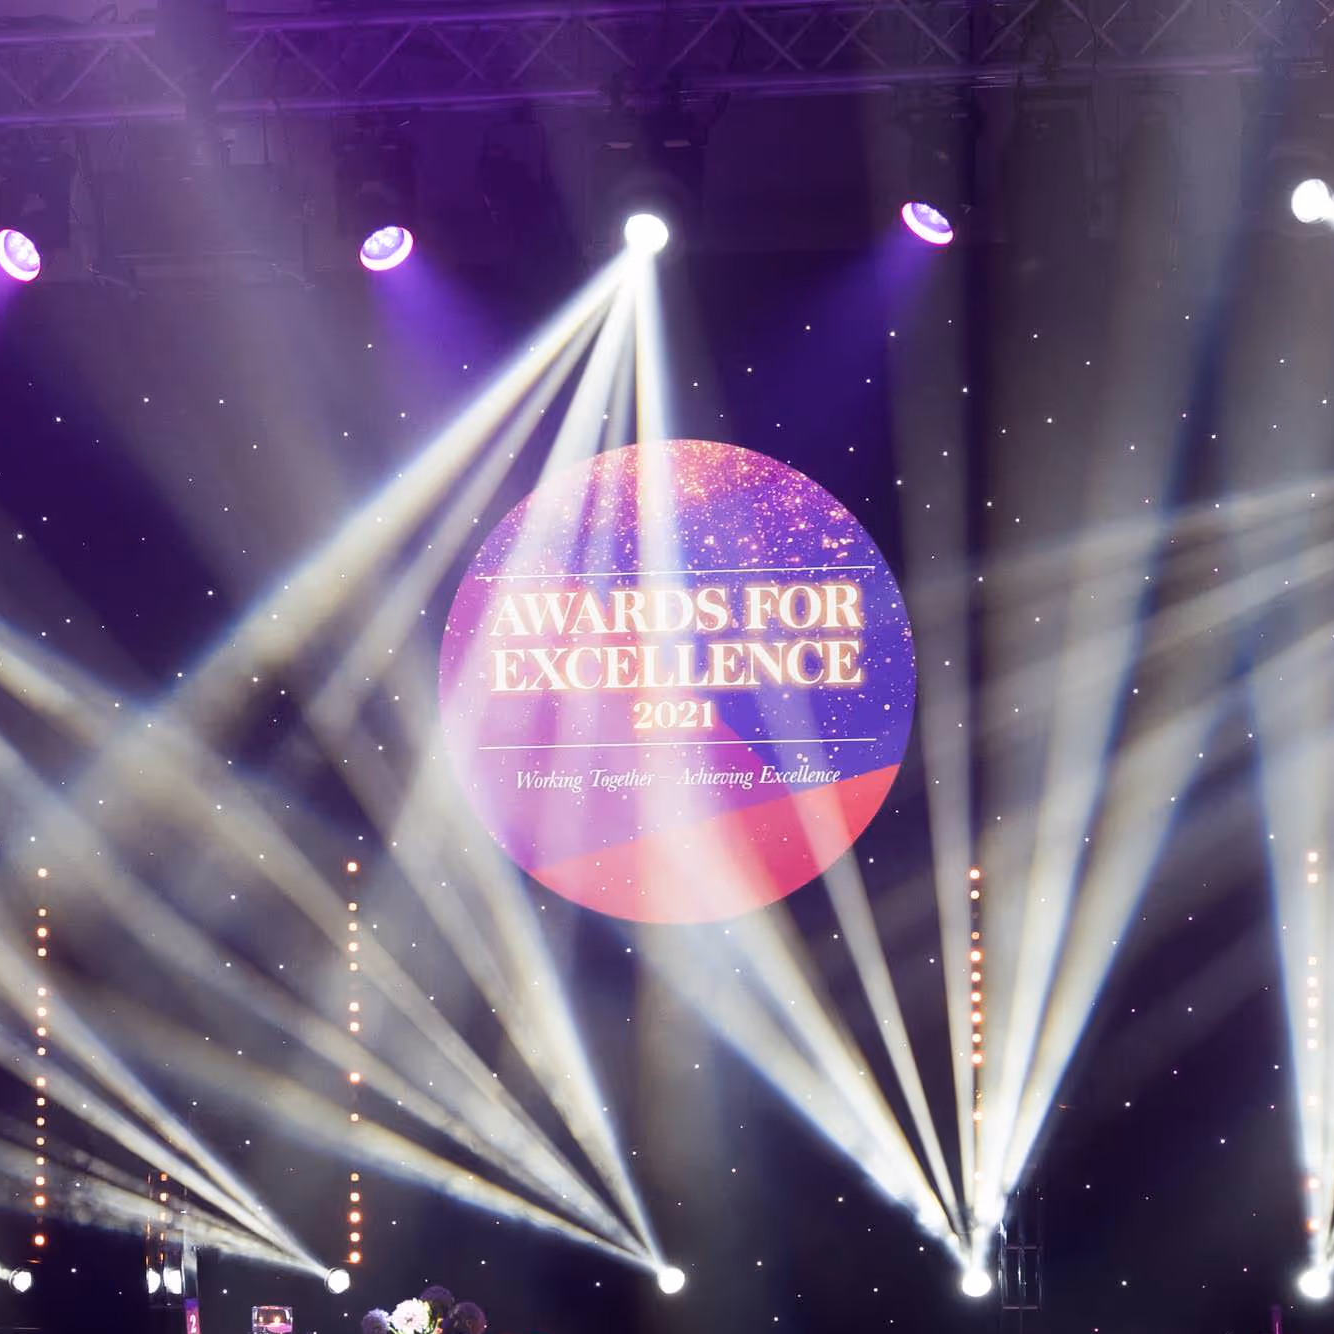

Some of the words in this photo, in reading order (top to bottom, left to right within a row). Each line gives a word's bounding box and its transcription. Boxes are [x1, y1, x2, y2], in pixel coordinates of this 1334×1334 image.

[490, 586, 730, 636] AWARDS
[746, 582, 863, 632] FOR
[491, 638, 862, 693] EXCELLENCE
[633, 700, 714, 730] 2021
[515, 770, 583, 793] Working
[590, 769, 654, 791] Together
[676, 766, 754, 790] Achieving
[759, 765, 841, 785] Excellence
[190, 1314, 197, 1334] 2
